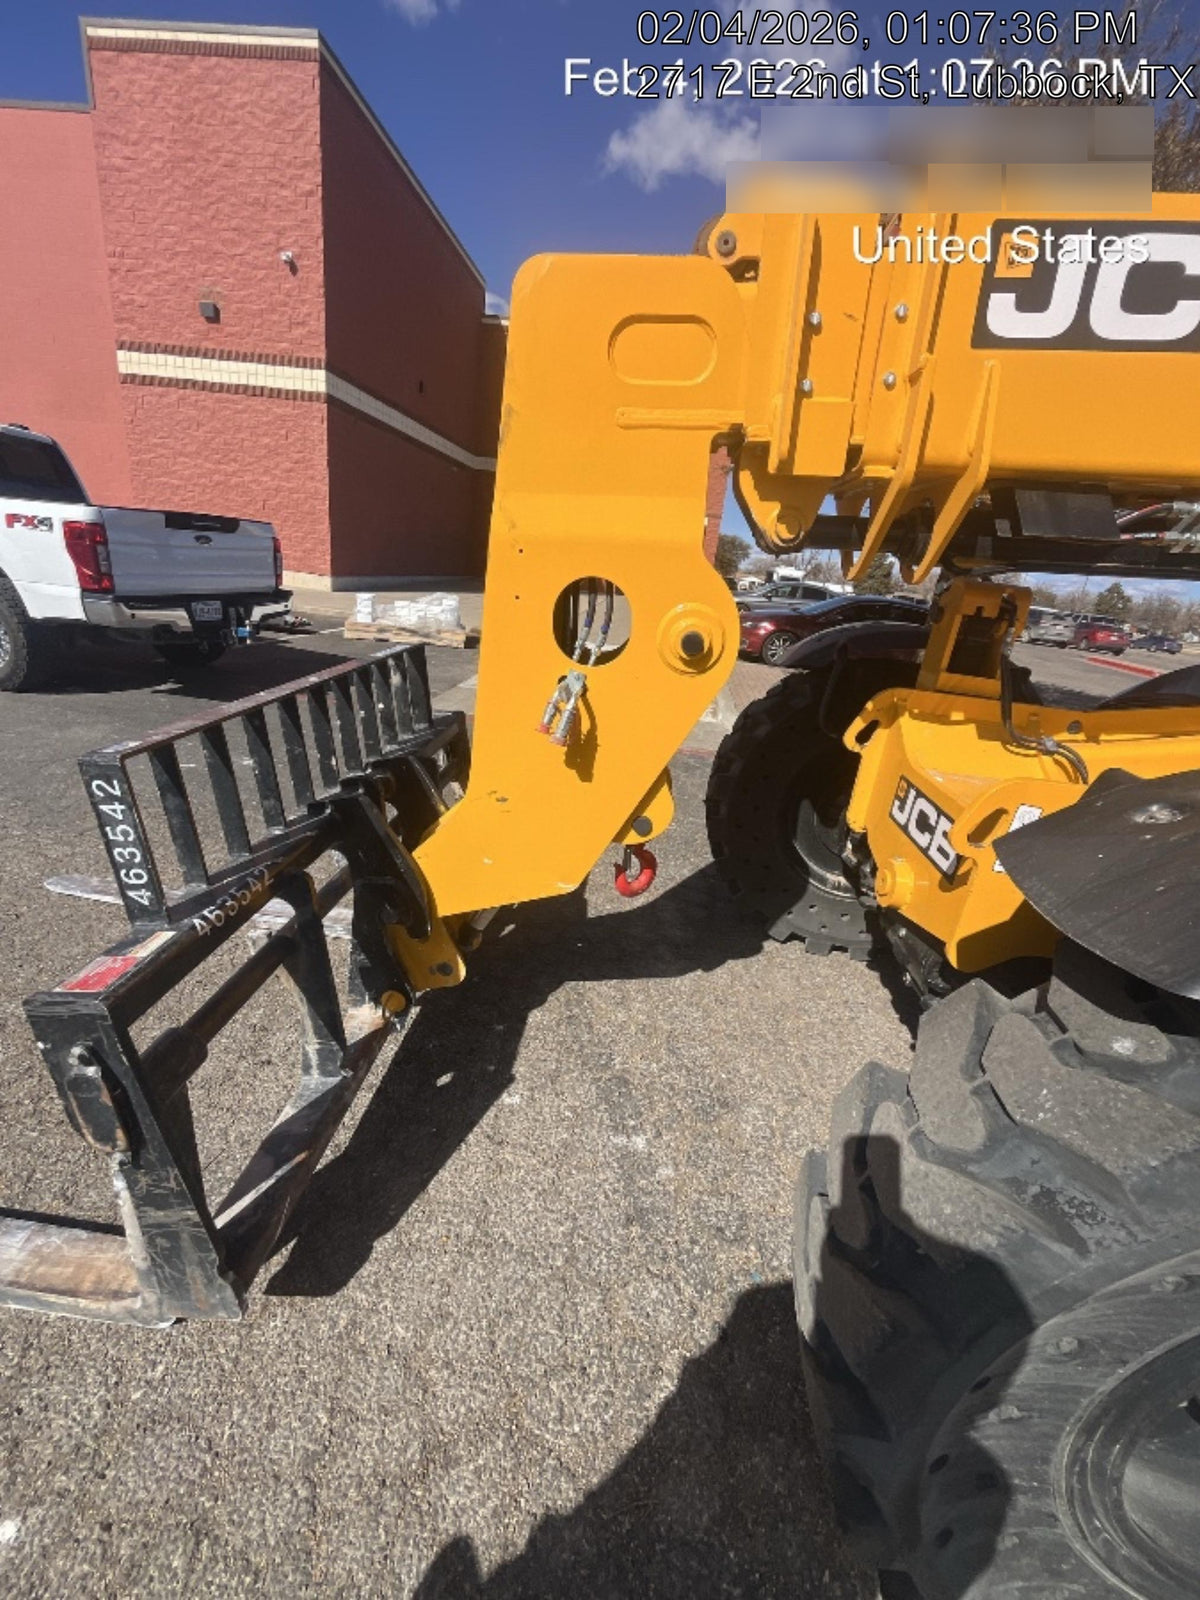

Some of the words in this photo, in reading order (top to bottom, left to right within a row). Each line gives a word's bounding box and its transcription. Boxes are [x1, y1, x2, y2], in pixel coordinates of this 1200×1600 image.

[5, 513, 54, 534] FX4
[91, 779, 152, 906] 463542
[891, 786, 958, 876] JCB
[192, 866, 275, 937] 463542
